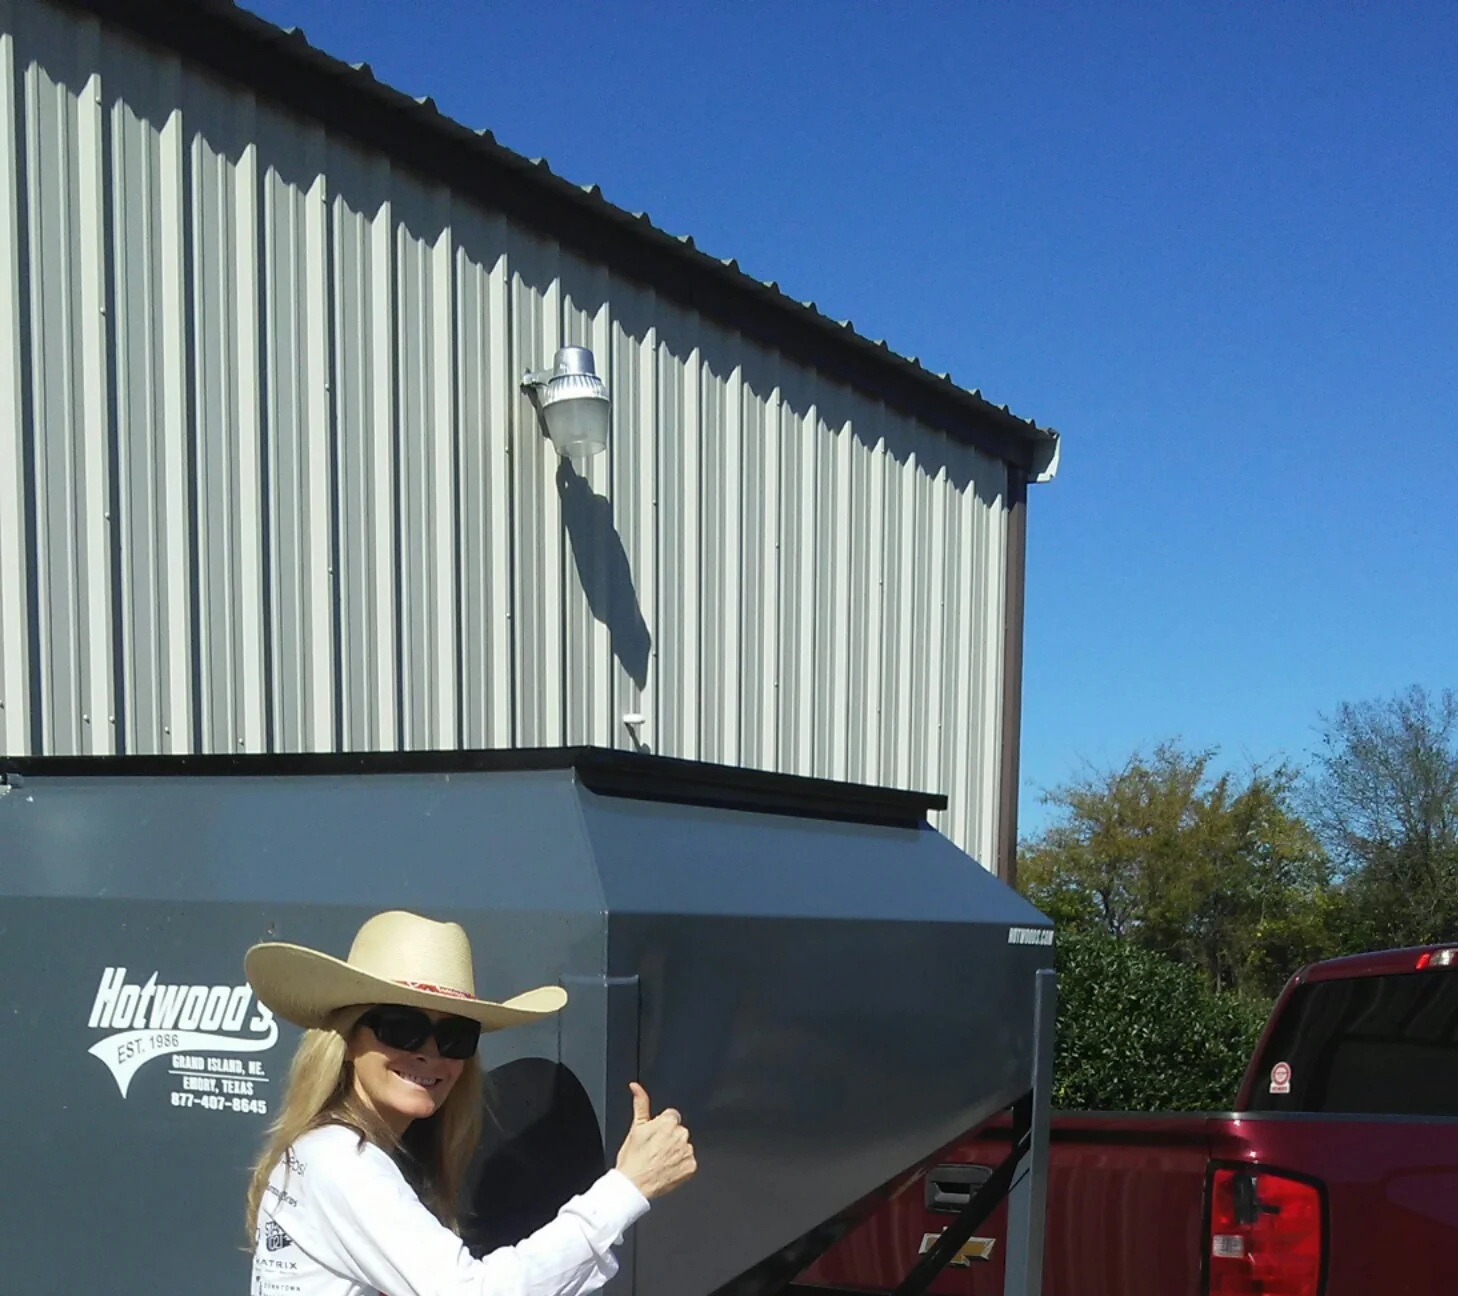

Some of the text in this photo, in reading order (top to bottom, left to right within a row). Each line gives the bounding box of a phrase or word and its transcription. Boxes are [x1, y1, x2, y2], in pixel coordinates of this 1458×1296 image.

[88, 967, 273, 1032] Hotwoods
[117, 1034, 180, 1065] EST. 1986
[172, 1054, 265, 1076] GRAND ISLAND, NE.
[183, 1076, 254, 1096] EMORY, TEXAS
[170, 1092, 267, 1114] 877-407-8645
